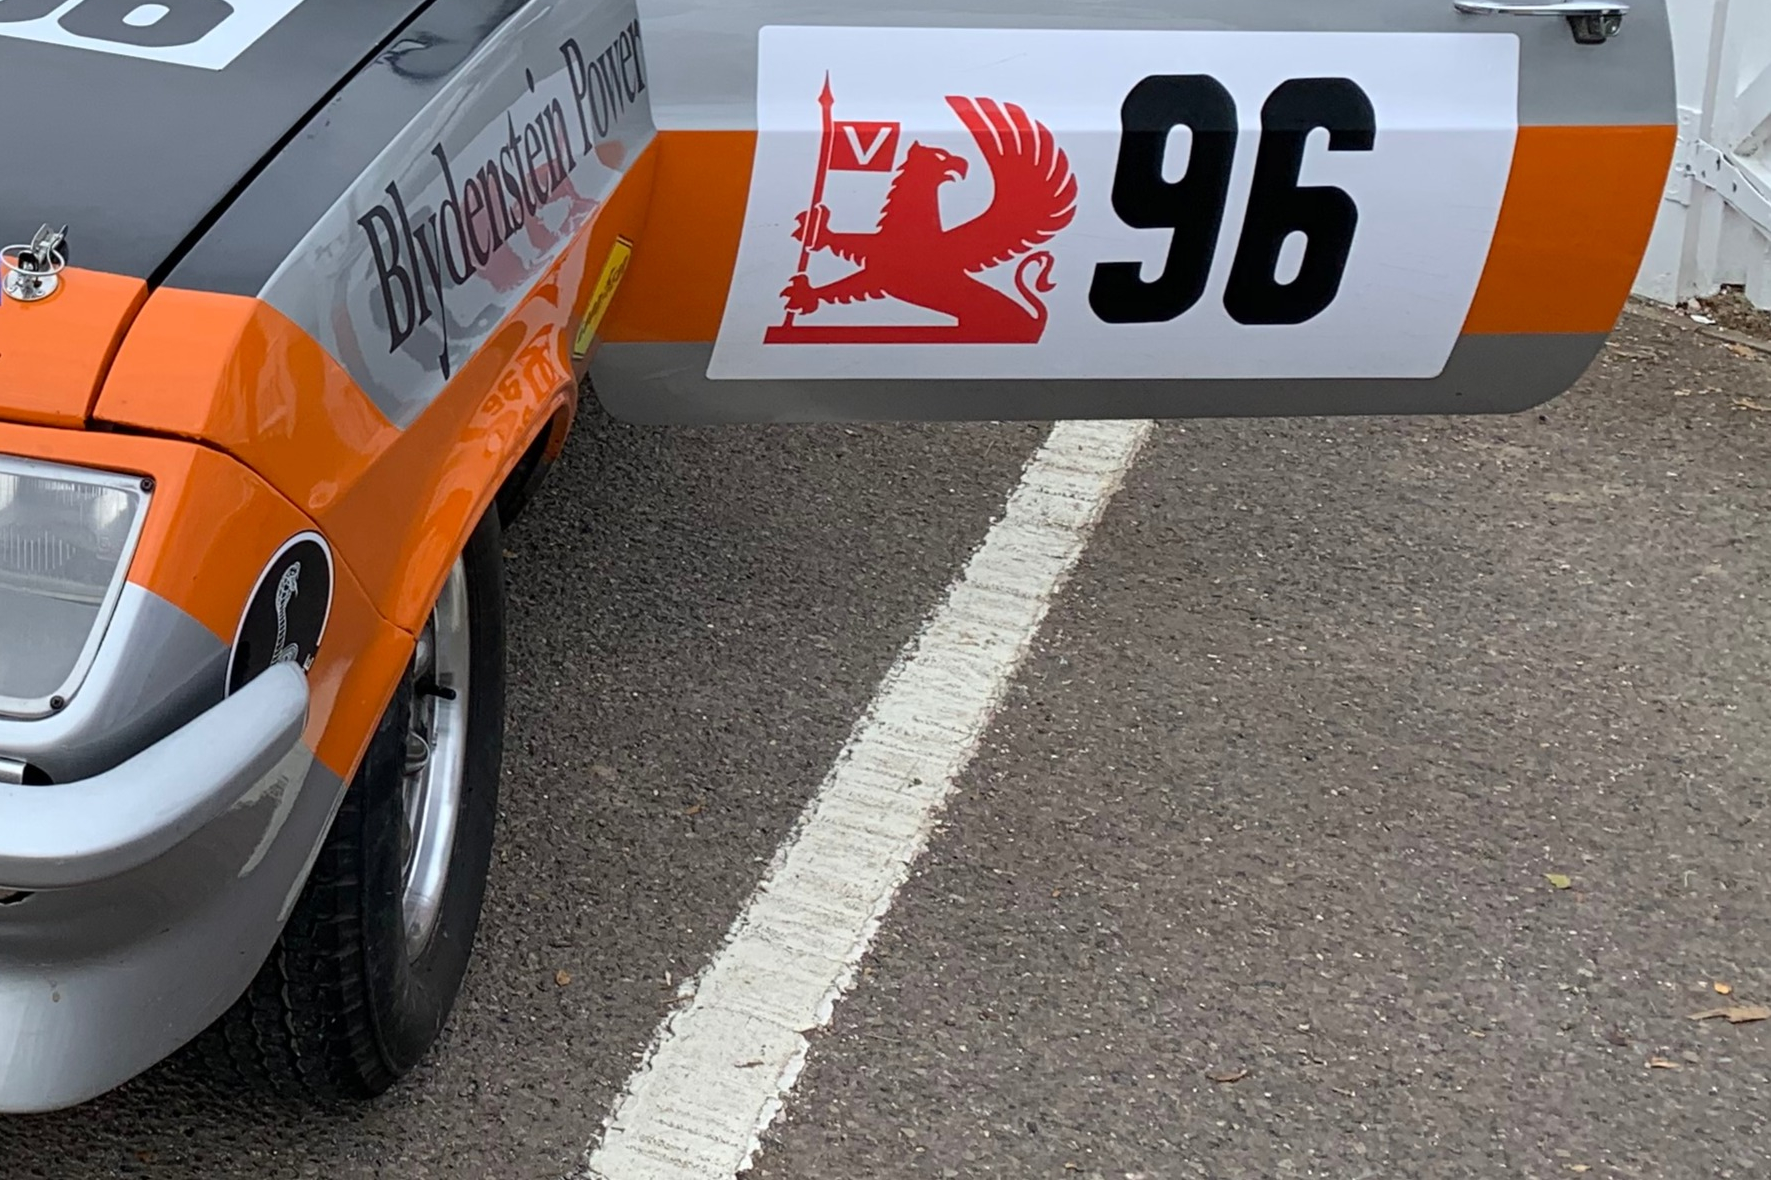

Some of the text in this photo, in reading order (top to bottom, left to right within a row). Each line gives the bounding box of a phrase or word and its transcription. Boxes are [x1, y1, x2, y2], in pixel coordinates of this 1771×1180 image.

[357, 18, 646, 381] Blydenstein Power
[842, 126, 896, 169] V
[1089, 73, 1376, 324] 96
